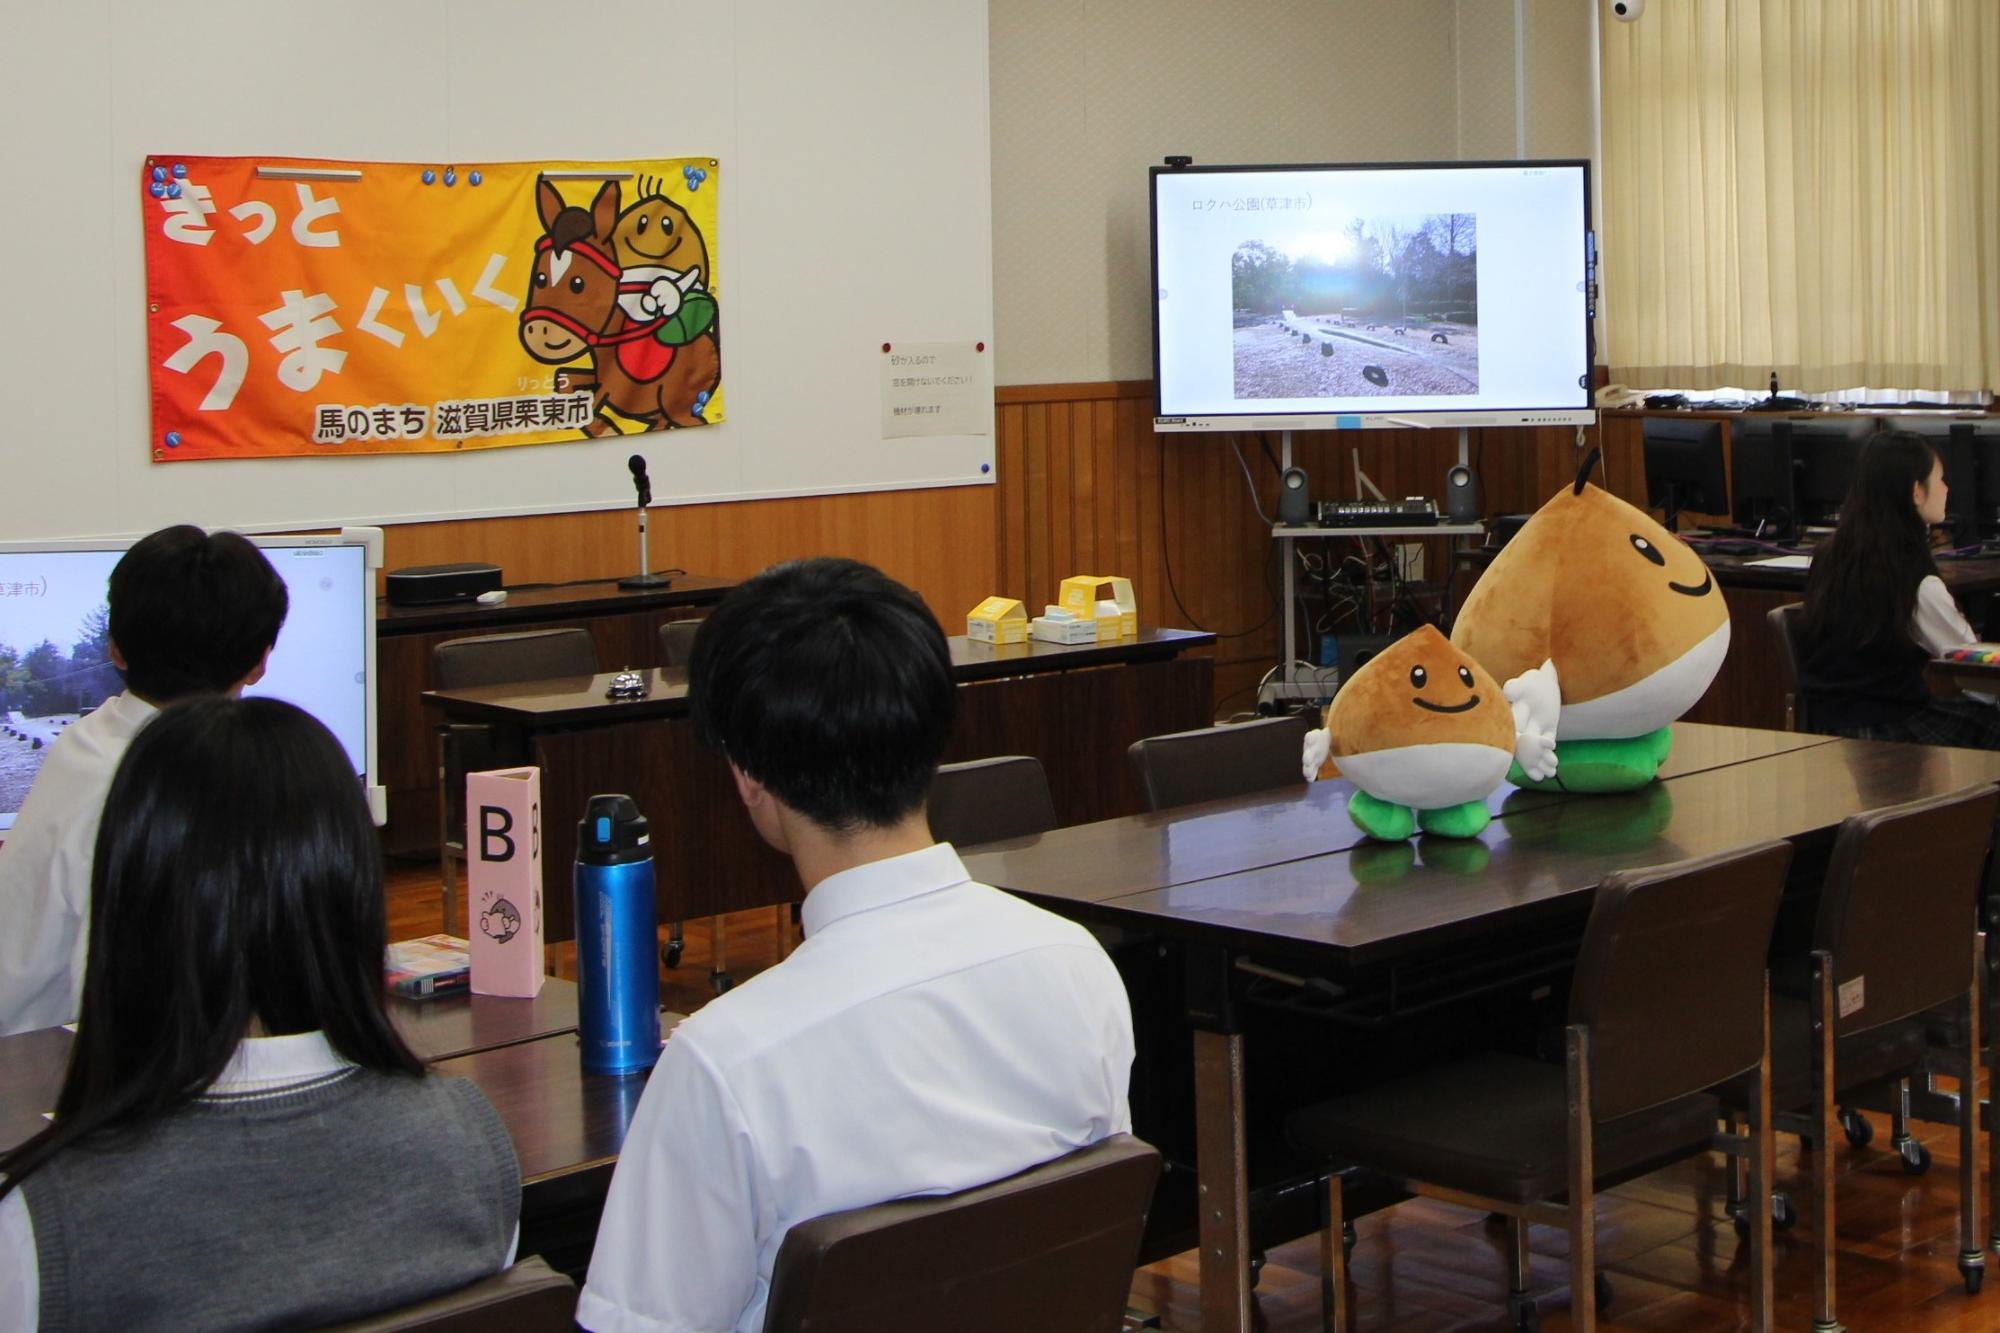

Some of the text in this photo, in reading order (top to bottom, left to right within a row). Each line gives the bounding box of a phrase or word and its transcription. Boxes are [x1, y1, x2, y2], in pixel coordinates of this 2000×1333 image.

[160, 177, 341, 248] きっと
[162, 253, 519, 411] うまくいく
[517, 373, 570, 391] りっとう
[317, 395, 590, 439] 馬のまち 滋賀県栗東市
[479, 804, 516, 863] B
